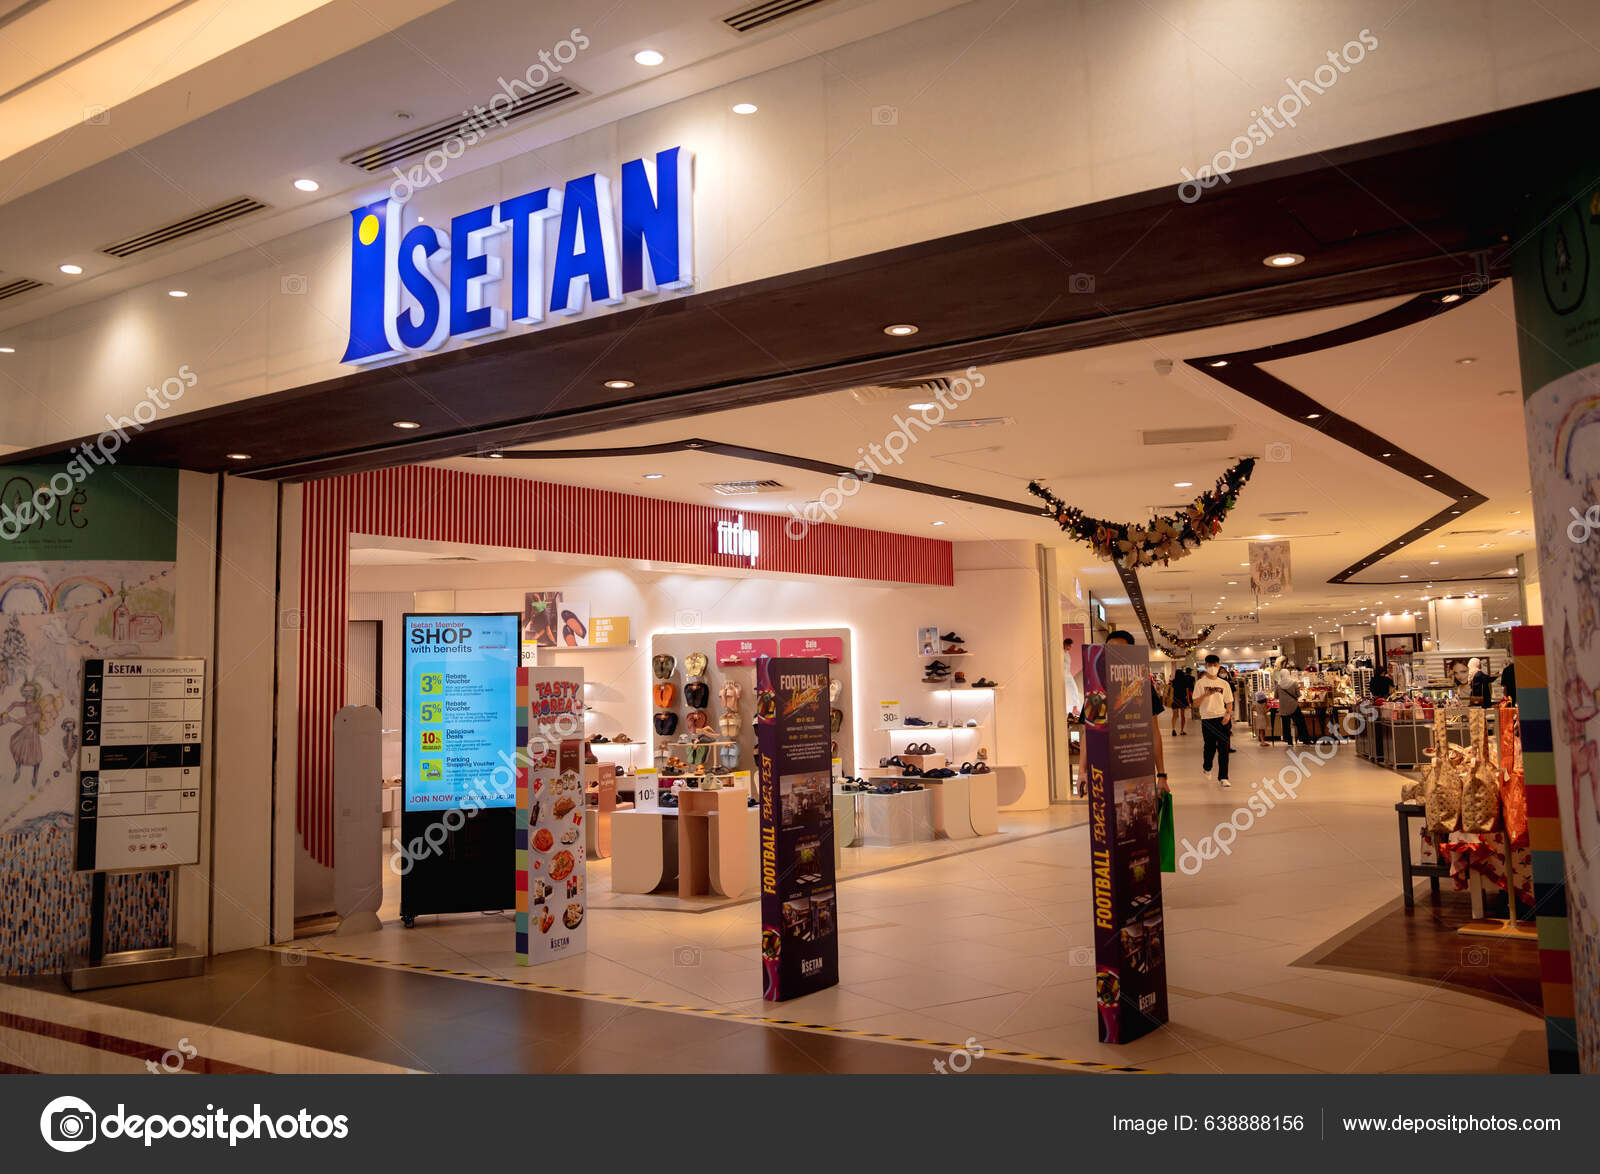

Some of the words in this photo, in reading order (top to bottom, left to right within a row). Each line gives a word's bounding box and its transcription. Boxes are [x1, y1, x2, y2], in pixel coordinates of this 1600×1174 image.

[411, 628, 473, 645] SHOP
[805, 640, 817, 649] Sale
[411, 645, 432, 654] with
[434, 645, 472, 653] benefits
[741, 641, 753, 650] Sale
[108, 662, 143, 674] ISETAN
[1110, 664, 1147, 682] FOOTBALL
[422, 675, 442, 693] 3%
[535, 680, 580, 699] TASTY
[780, 674, 820, 691] FOOTBALL
[421, 704, 442, 721] 5%
[410, 795, 430, 803] JOIN
[432, 794, 453, 802] NOW
[763, 826, 777, 895] FOOTBALL
[1094, 849, 1113, 930] FOOTBALL
